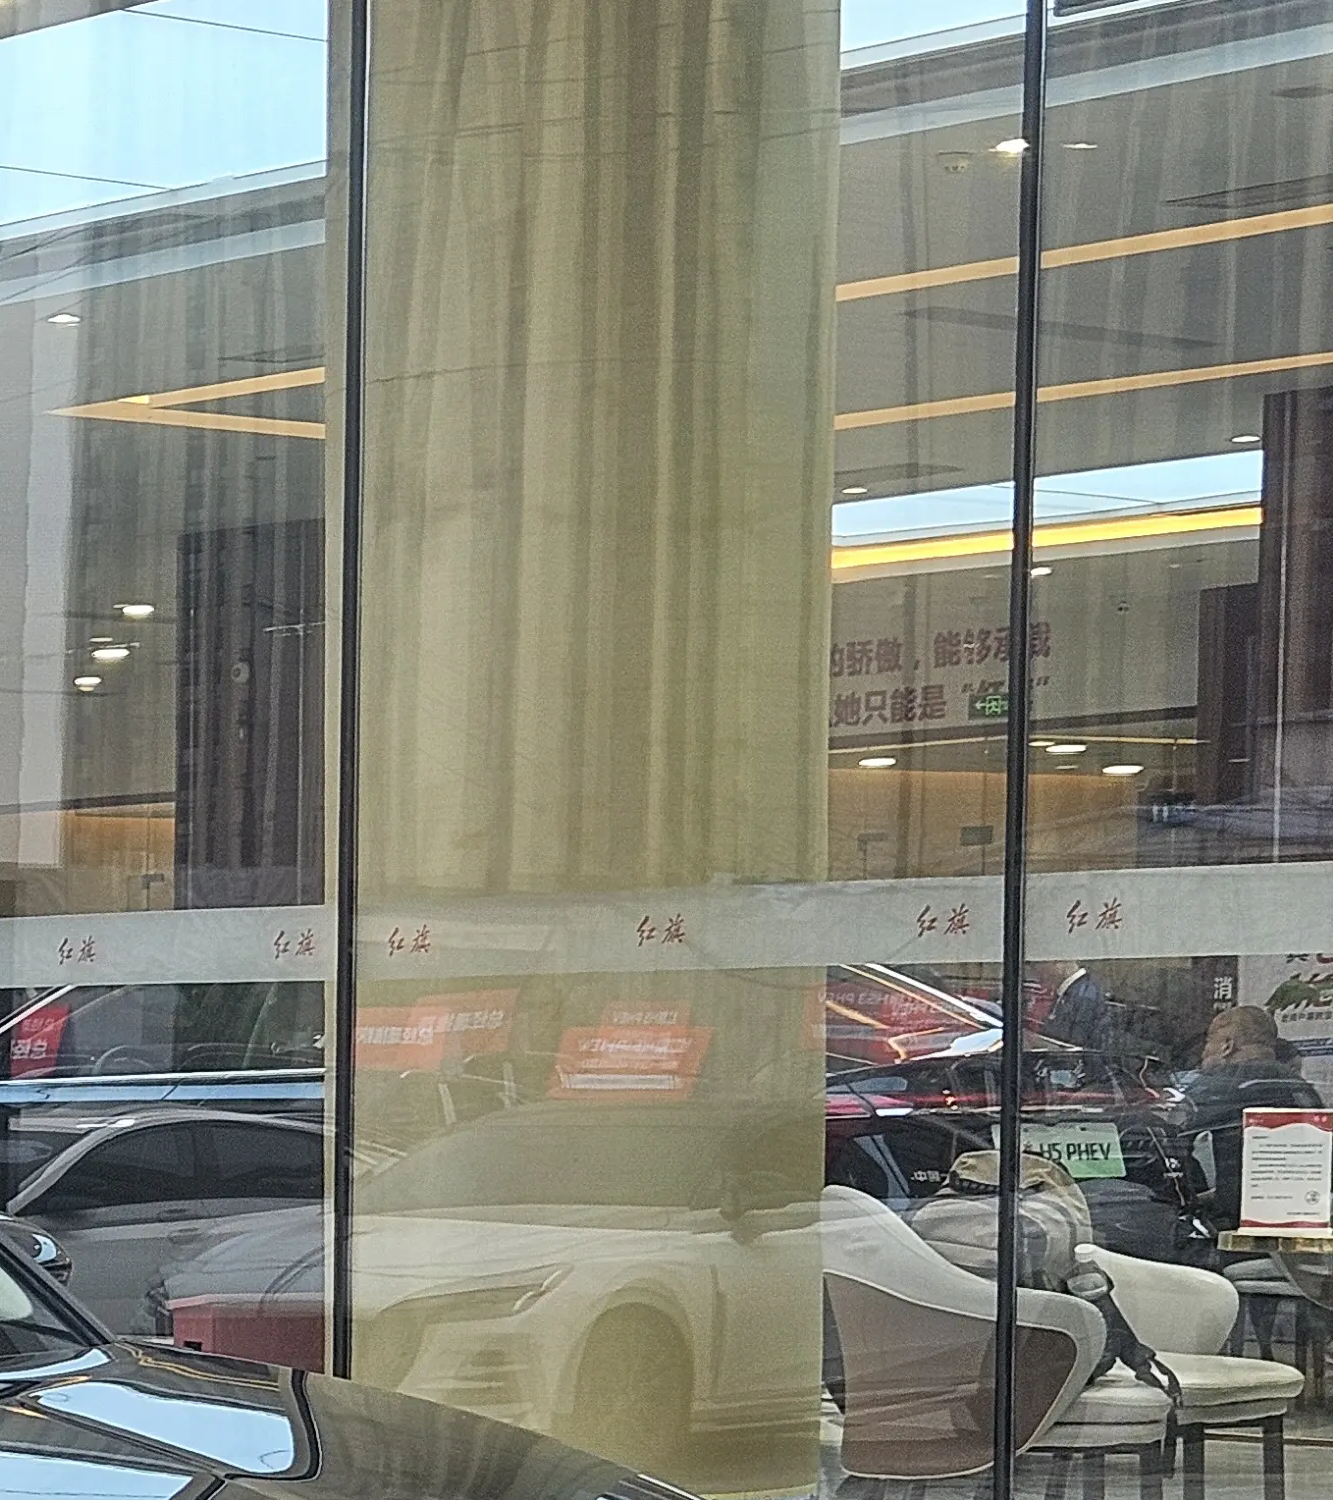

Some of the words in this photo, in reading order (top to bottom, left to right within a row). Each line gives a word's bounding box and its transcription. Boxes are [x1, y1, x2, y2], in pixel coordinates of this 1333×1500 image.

[636, 912, 686, 948] 红旗
[916, 902, 970, 938] 红旗
[1065, 896, 1124, 935] 红旗
[57, 934, 96, 966] 红旗
[273, 927, 317, 960] 红旗
[387, 923, 432, 957] 红旗
[1066, 1142, 1112, 1161] PHEV
